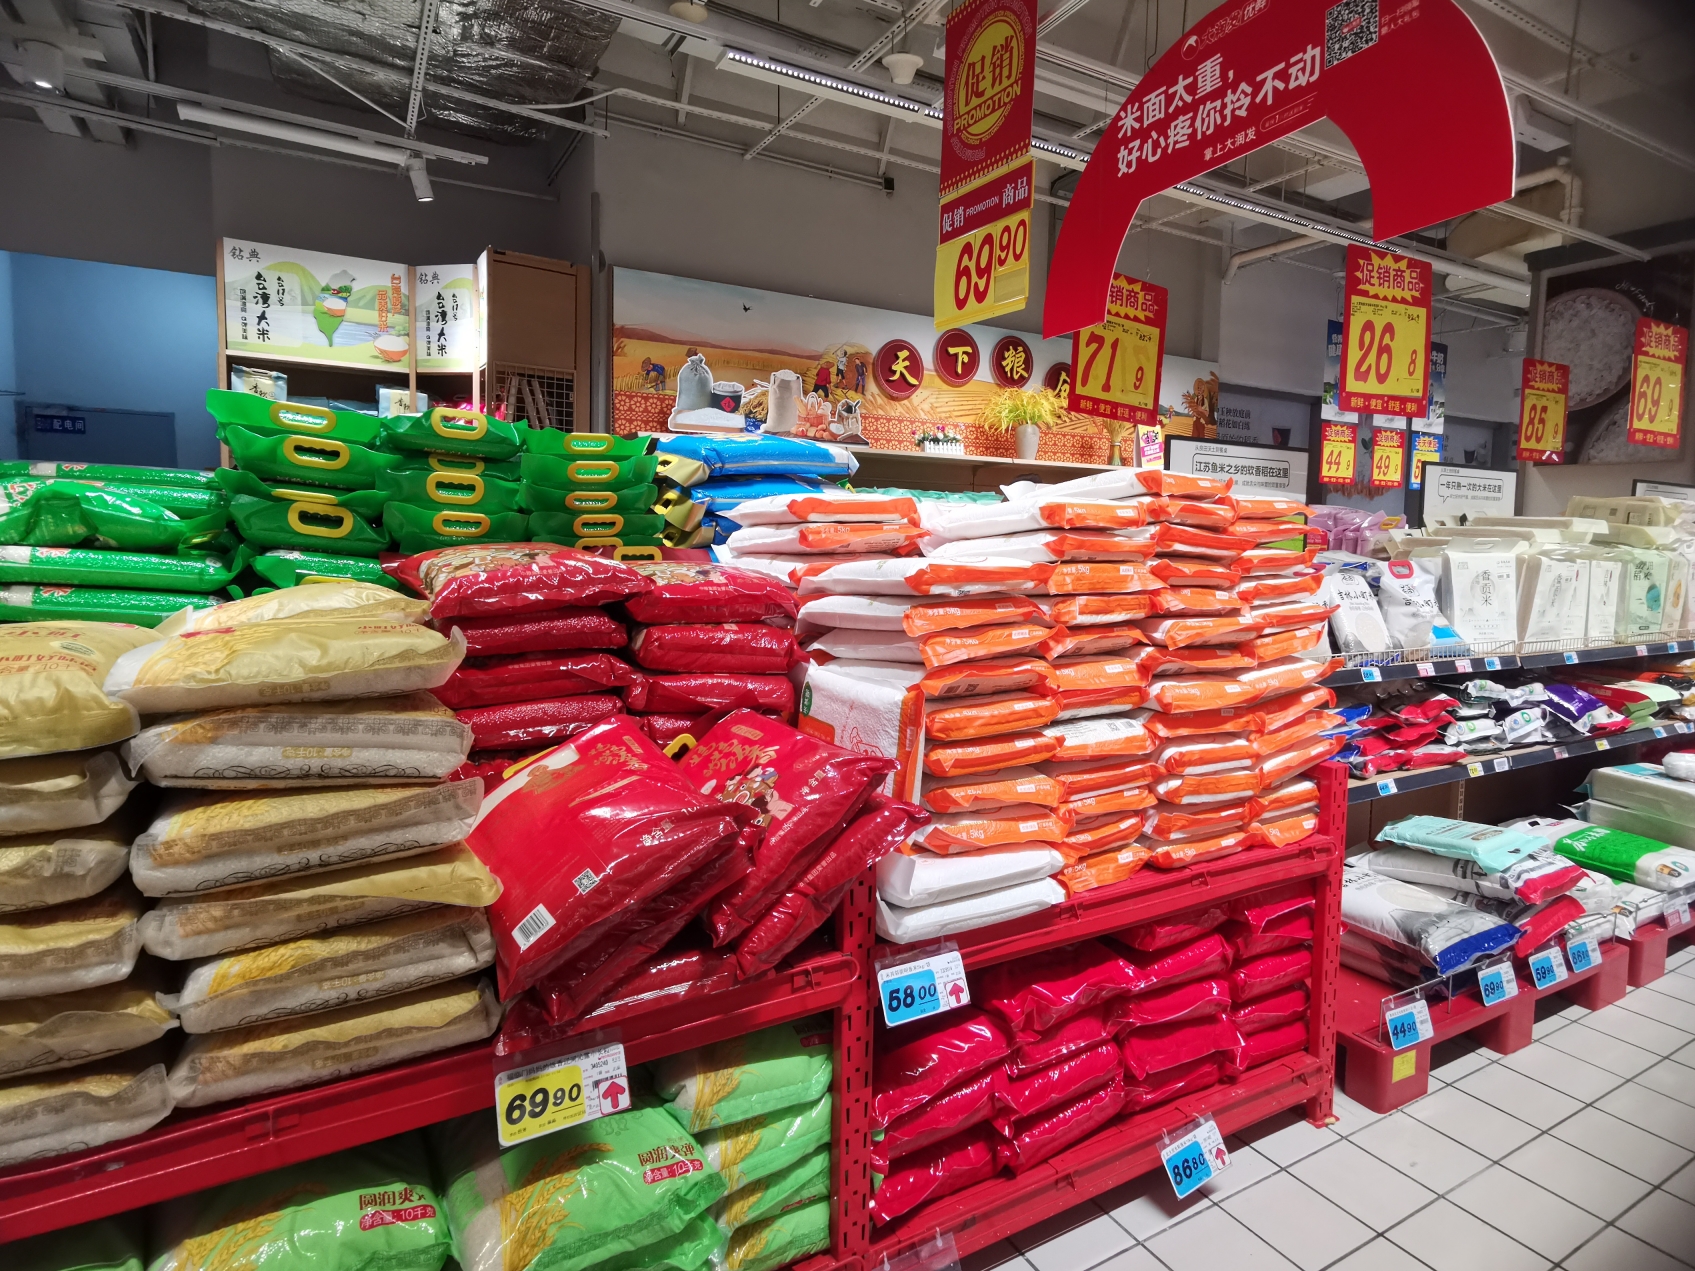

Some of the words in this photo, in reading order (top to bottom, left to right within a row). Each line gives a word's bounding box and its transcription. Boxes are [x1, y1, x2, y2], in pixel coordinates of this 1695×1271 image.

[962, 34, 1015, 107] 促销
[953, 80, 1022, 134] PROMOTION
[1117, 43, 1321, 178] 好心疼你拎不动
[1203, 126, 1256, 162] 掌上大润发
[941, 205, 965, 234] 促销
[965, 195, 1000, 218] PROMOTION
[1001, 176, 1029, 209] 商品
[1360, 260, 1421, 293] 促销商品
[253, 271, 271, 343] 台湾大米
[434, 291, 448, 357] 台湾大米
[1194, 461, 1289, 479] 江苏鱼米之乡的软香稻在这里
